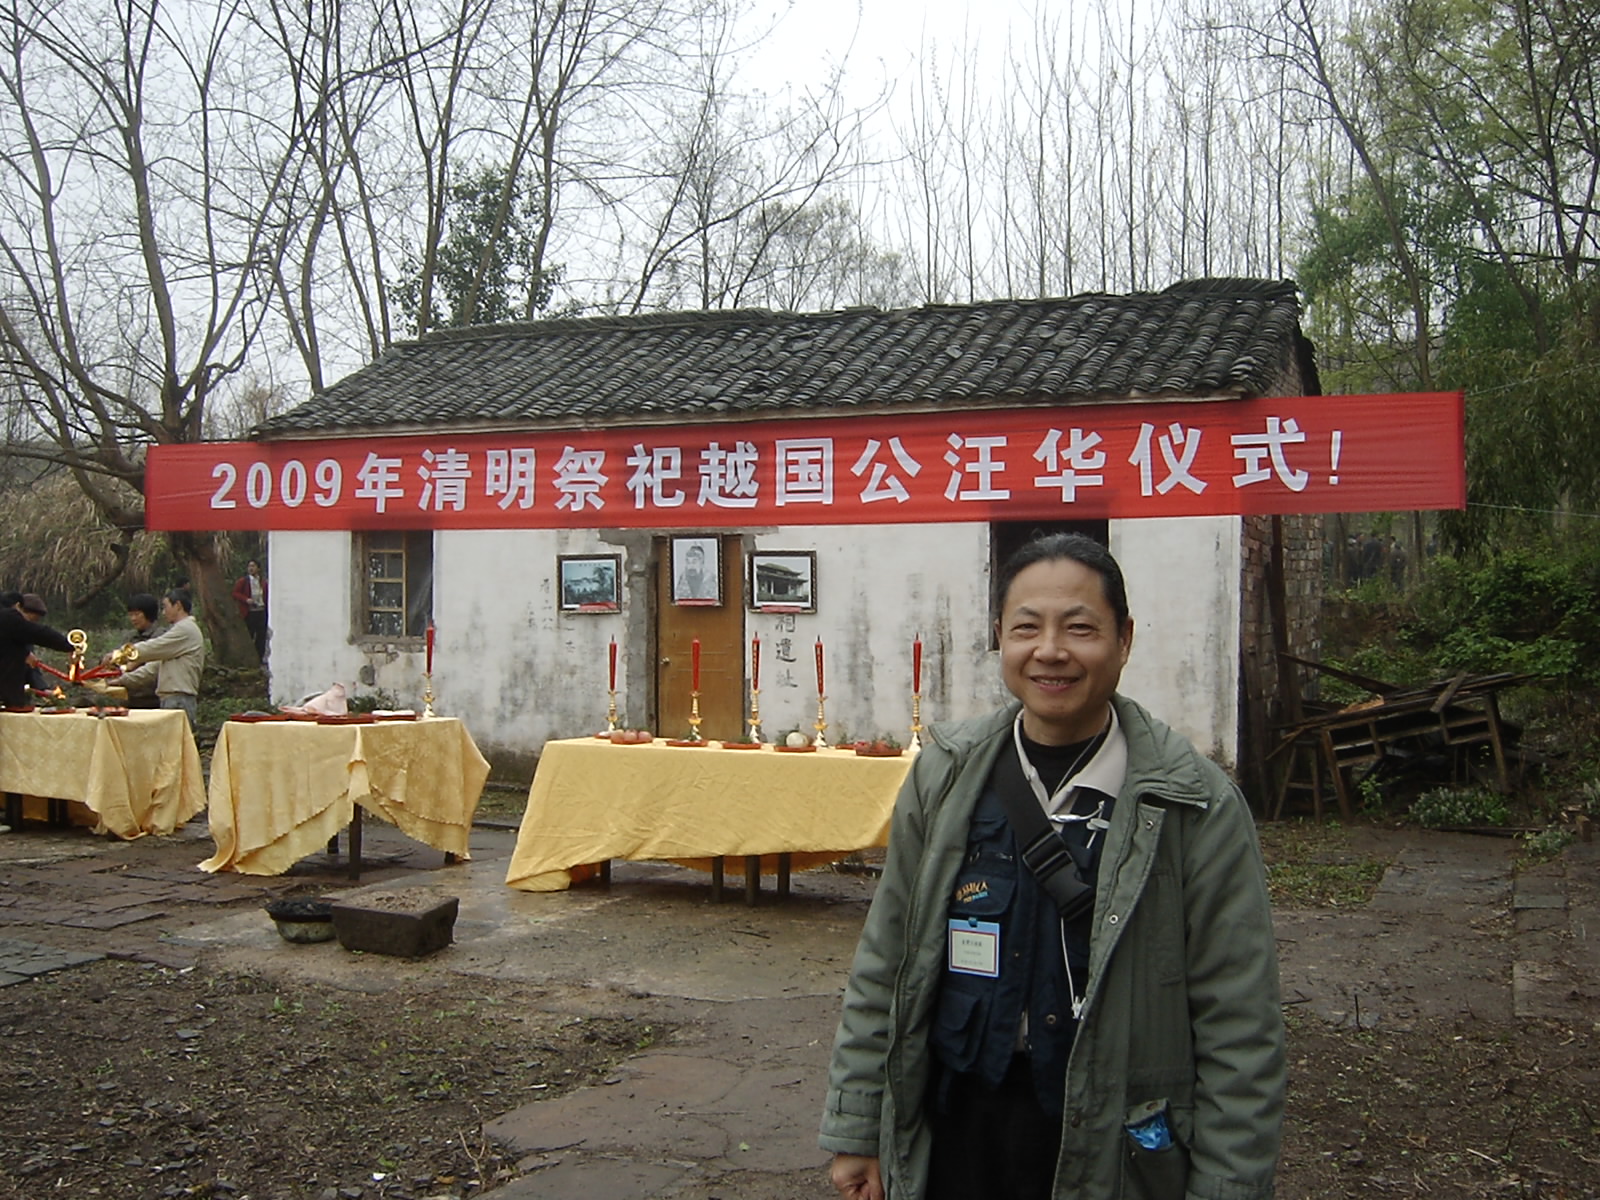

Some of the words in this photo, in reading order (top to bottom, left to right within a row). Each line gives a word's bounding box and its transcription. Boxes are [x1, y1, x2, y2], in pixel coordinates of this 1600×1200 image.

[210, 417, 1343, 513] 2009年清明祭祀越国公汪华仪式!
